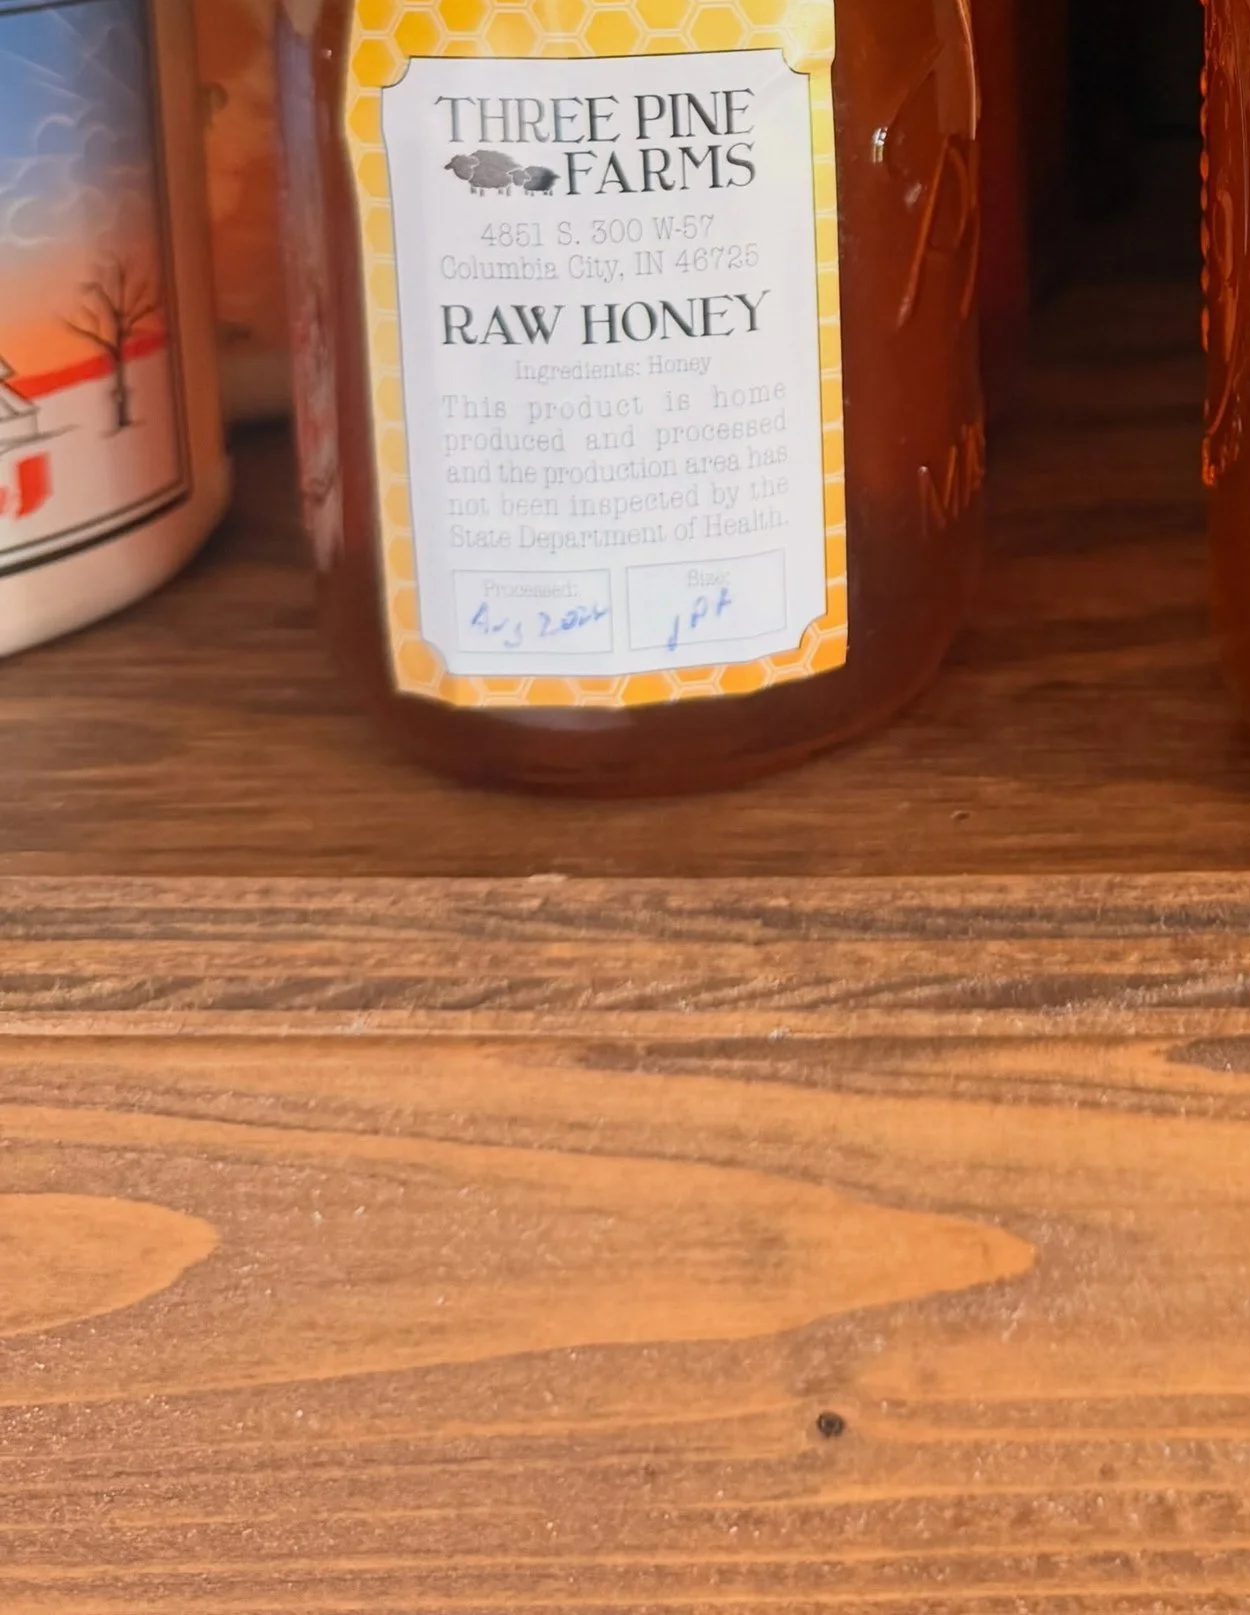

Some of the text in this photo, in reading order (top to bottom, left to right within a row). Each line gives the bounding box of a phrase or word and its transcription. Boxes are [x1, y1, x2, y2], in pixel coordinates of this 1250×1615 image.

[435, 87, 756, 144] THREE PINE
[565, 141, 757, 196] FARMS
[480, 213, 715, 248] 4851 S. 300 W-57
[440, 243, 760, 284] Columbia City, IN 46725
[440, 289, 772, 347] RAW HONEY
[514, 355, 712, 383] Ingredients: Honey
[442, 381, 787, 425] This product is home
[444, 412, 787, 458] produced and processed
[446, 443, 788, 489] and the production area has
[448, 472, 789, 522] not been inspected by the
[450, 507, 790, 555] State Department of Health.
